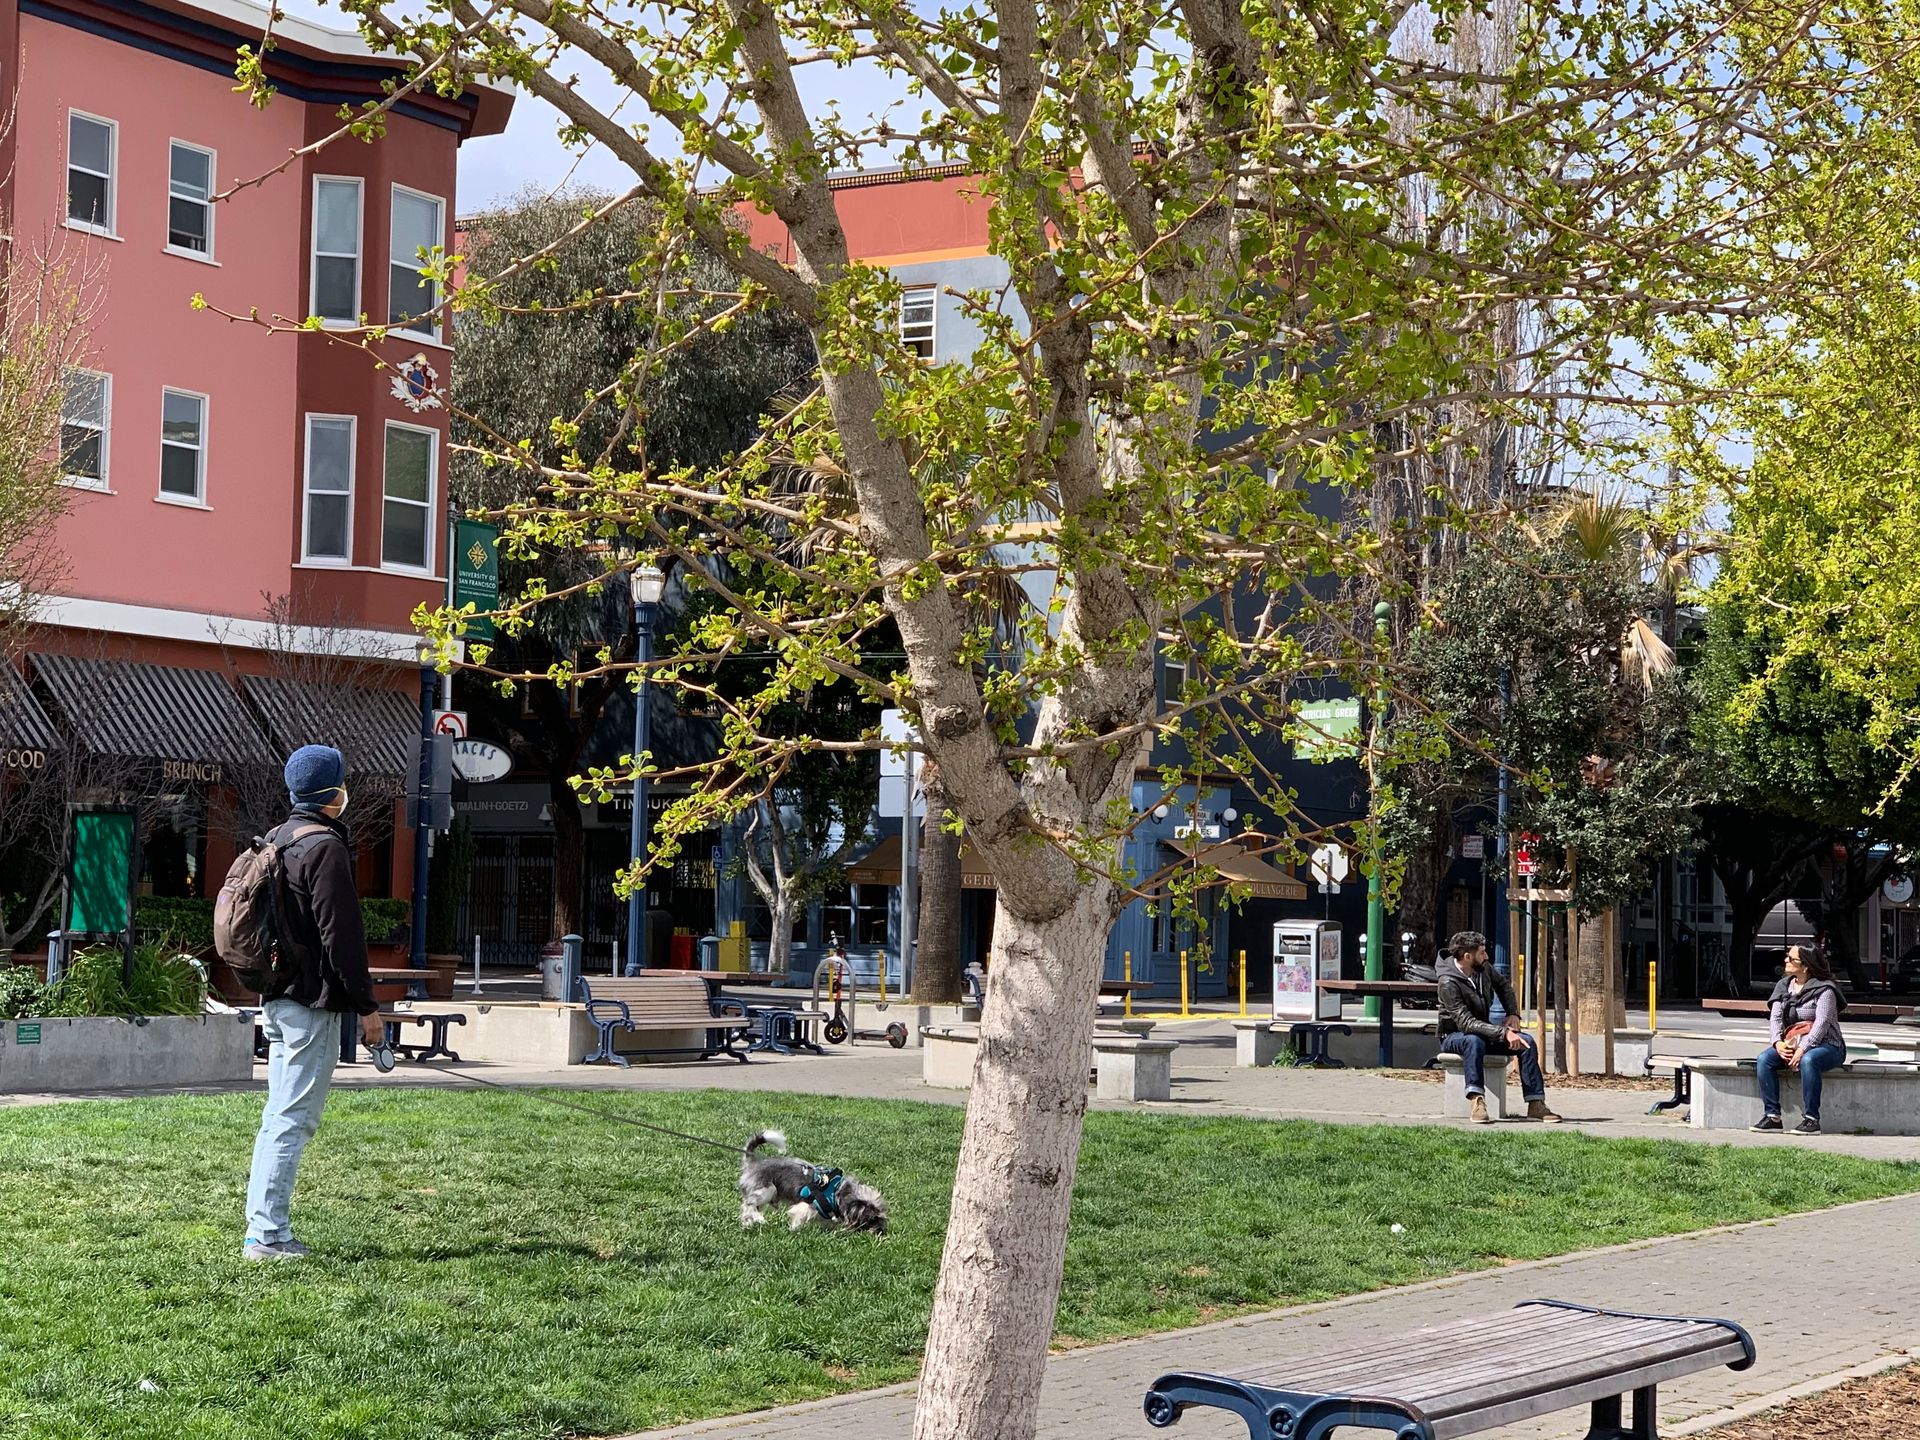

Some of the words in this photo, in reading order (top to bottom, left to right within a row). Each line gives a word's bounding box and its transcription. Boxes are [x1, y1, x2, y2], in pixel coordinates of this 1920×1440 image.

[459, 570, 488, 580] UNIVERSITY
[459, 577, 468, 585] SAN
[468, 579, 497, 589] FRANCISCO
[453, 742, 497, 761] TACKS
[163, 760, 222, 782] BRUNCH
[1251, 882, 1297, 896] OULANGERIE
